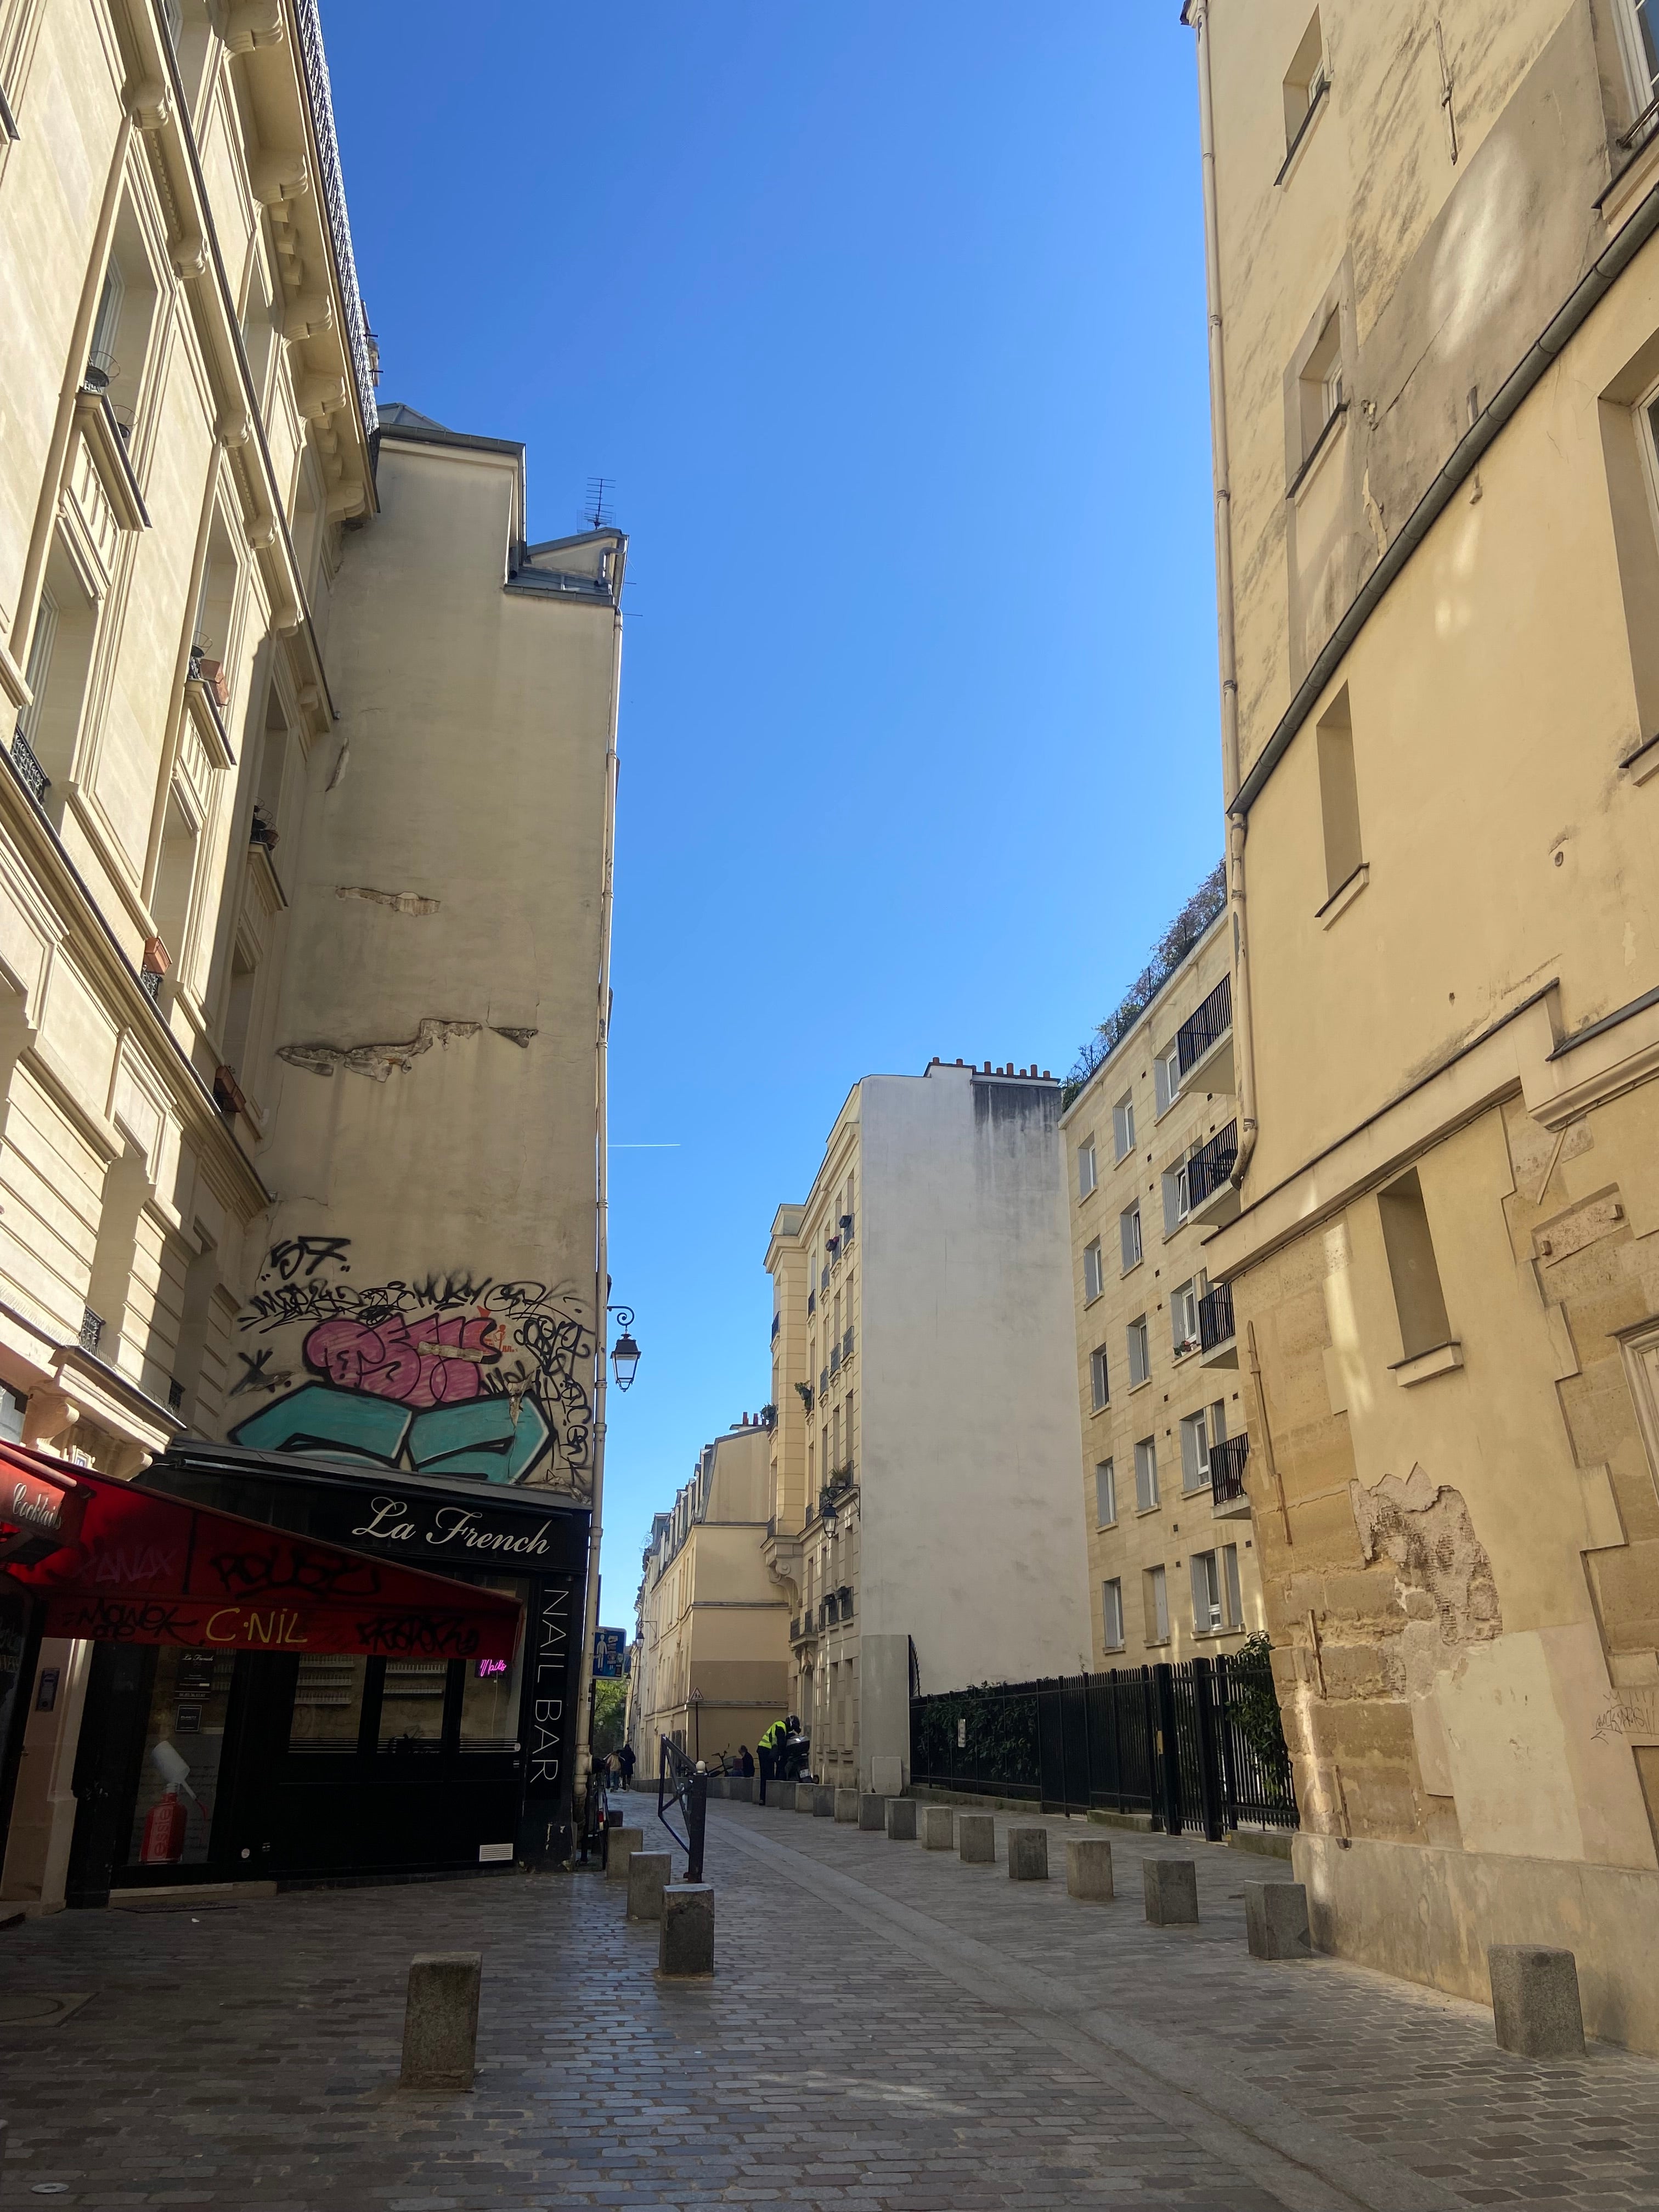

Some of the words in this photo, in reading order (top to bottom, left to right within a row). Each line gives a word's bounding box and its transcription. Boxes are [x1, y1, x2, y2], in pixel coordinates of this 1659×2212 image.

[352, 1497, 416, 1539] La
[426, 1507, 552, 1554] French
[537, 1589, 569, 1683] NAIL
[530, 1700, 562, 1783] BAR
[154, 1807, 171, 1856] essie
